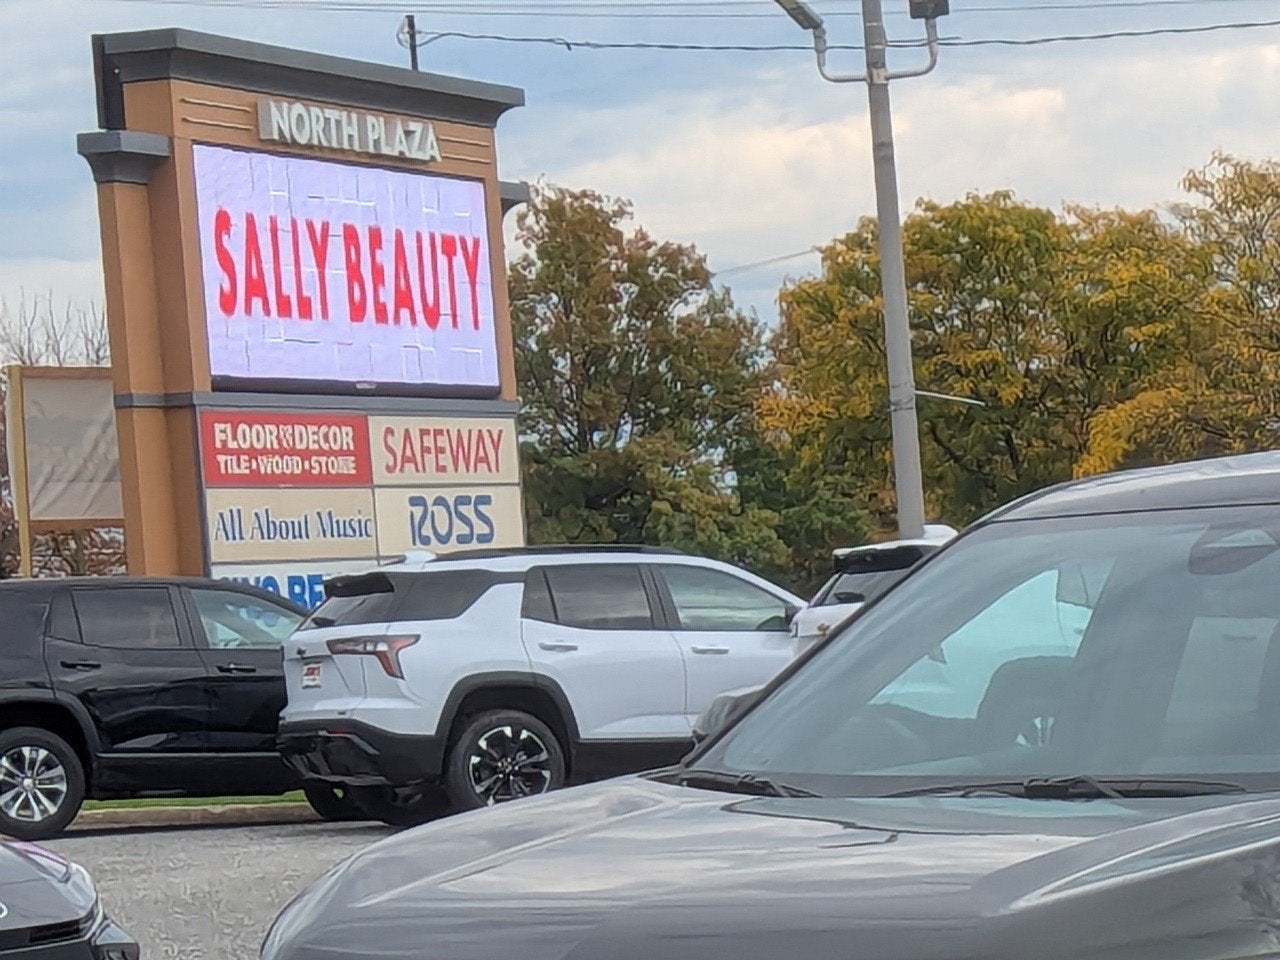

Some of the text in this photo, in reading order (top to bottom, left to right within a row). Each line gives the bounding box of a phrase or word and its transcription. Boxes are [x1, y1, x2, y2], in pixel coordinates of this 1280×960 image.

[269, 101, 441, 162] NORTH PLAZA
[215, 206, 481, 331] SALLY BEAUTY
[383, 426, 503, 474] SAFEWAY
[214, 508, 373, 542] All About Music
[409, 495, 495, 546] ROSS
